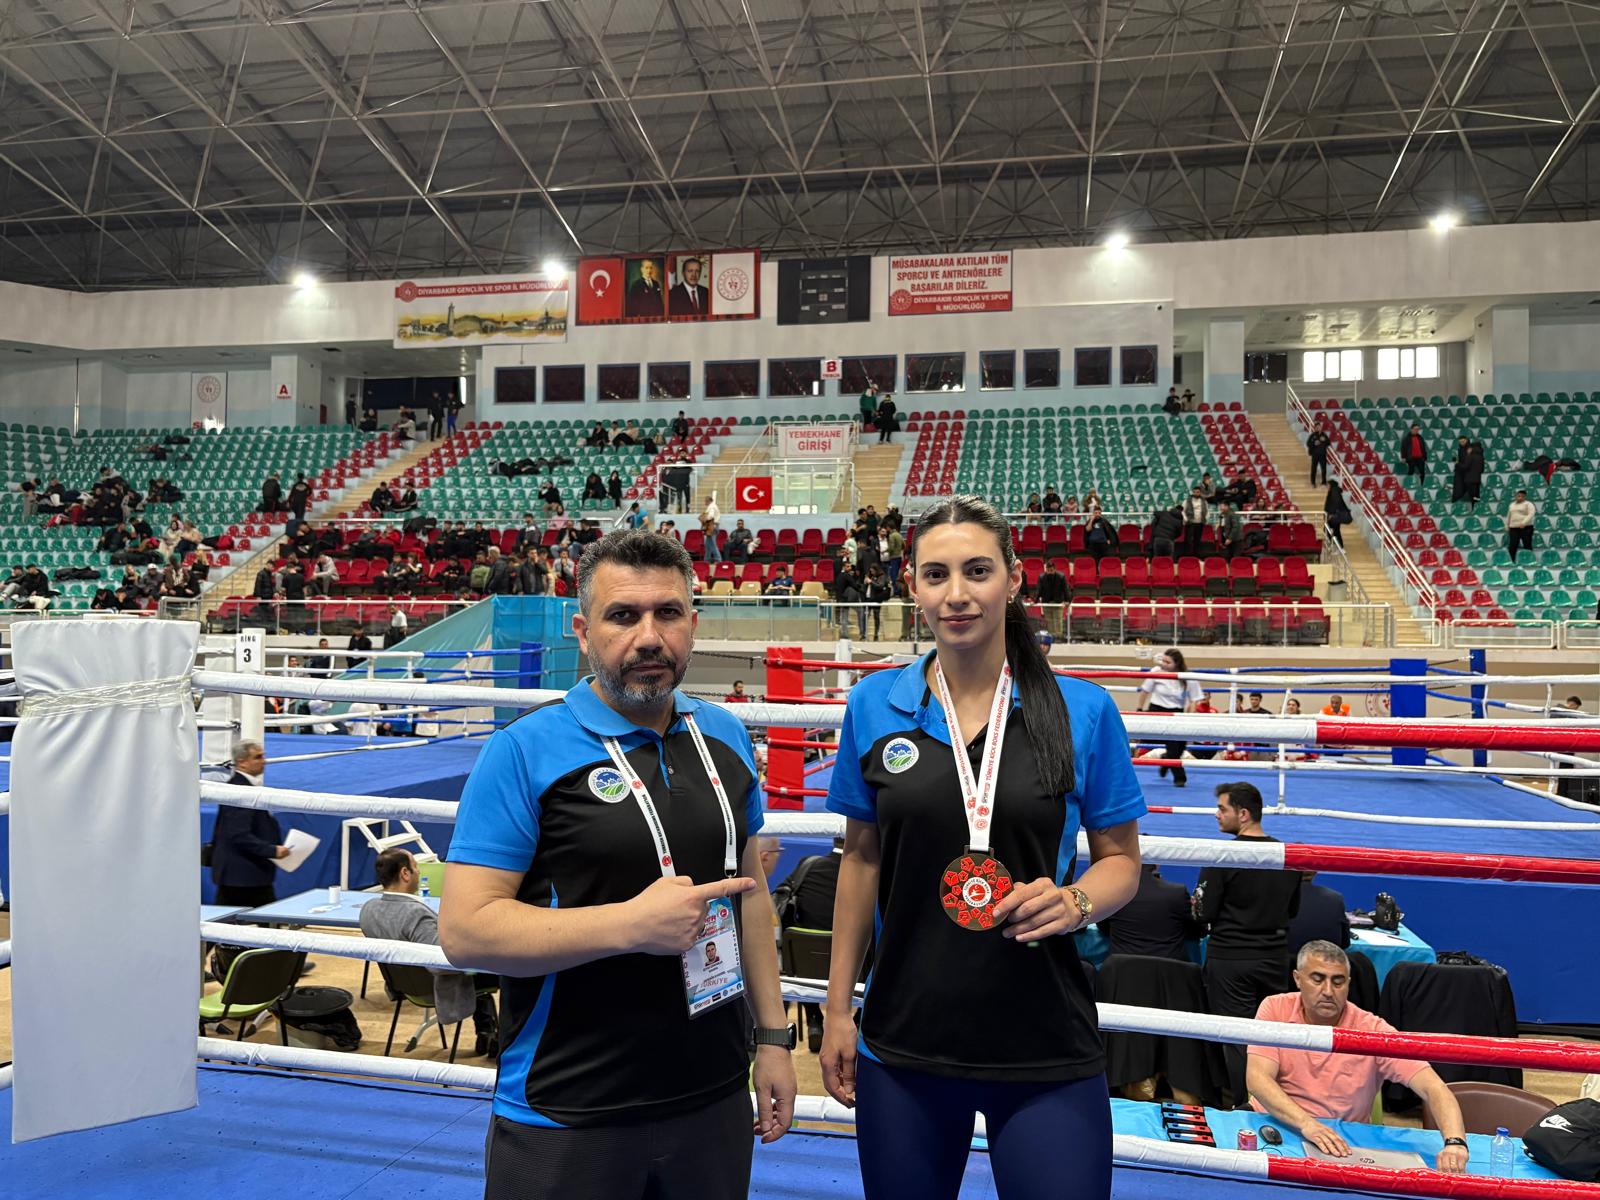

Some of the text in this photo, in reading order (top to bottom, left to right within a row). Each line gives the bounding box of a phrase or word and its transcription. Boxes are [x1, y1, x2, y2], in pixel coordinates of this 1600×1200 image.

[892, 253, 1008, 269] MÜSABAKALARA KATILAN TÜM
[897, 267, 1003, 281] SPORCU VE ANTRENÖRLERE
[494, 284, 511, 292] SPOR
[911, 279, 988, 293] BAŞARILAR DİLERİZ.
[826, 361, 837, 372] B
[279, 384, 288, 395] A
[789, 430, 842, 438] YEMEKHANE
[798, 439, 832, 453] GİRİŞİ
[243, 648, 252, 663] 3
